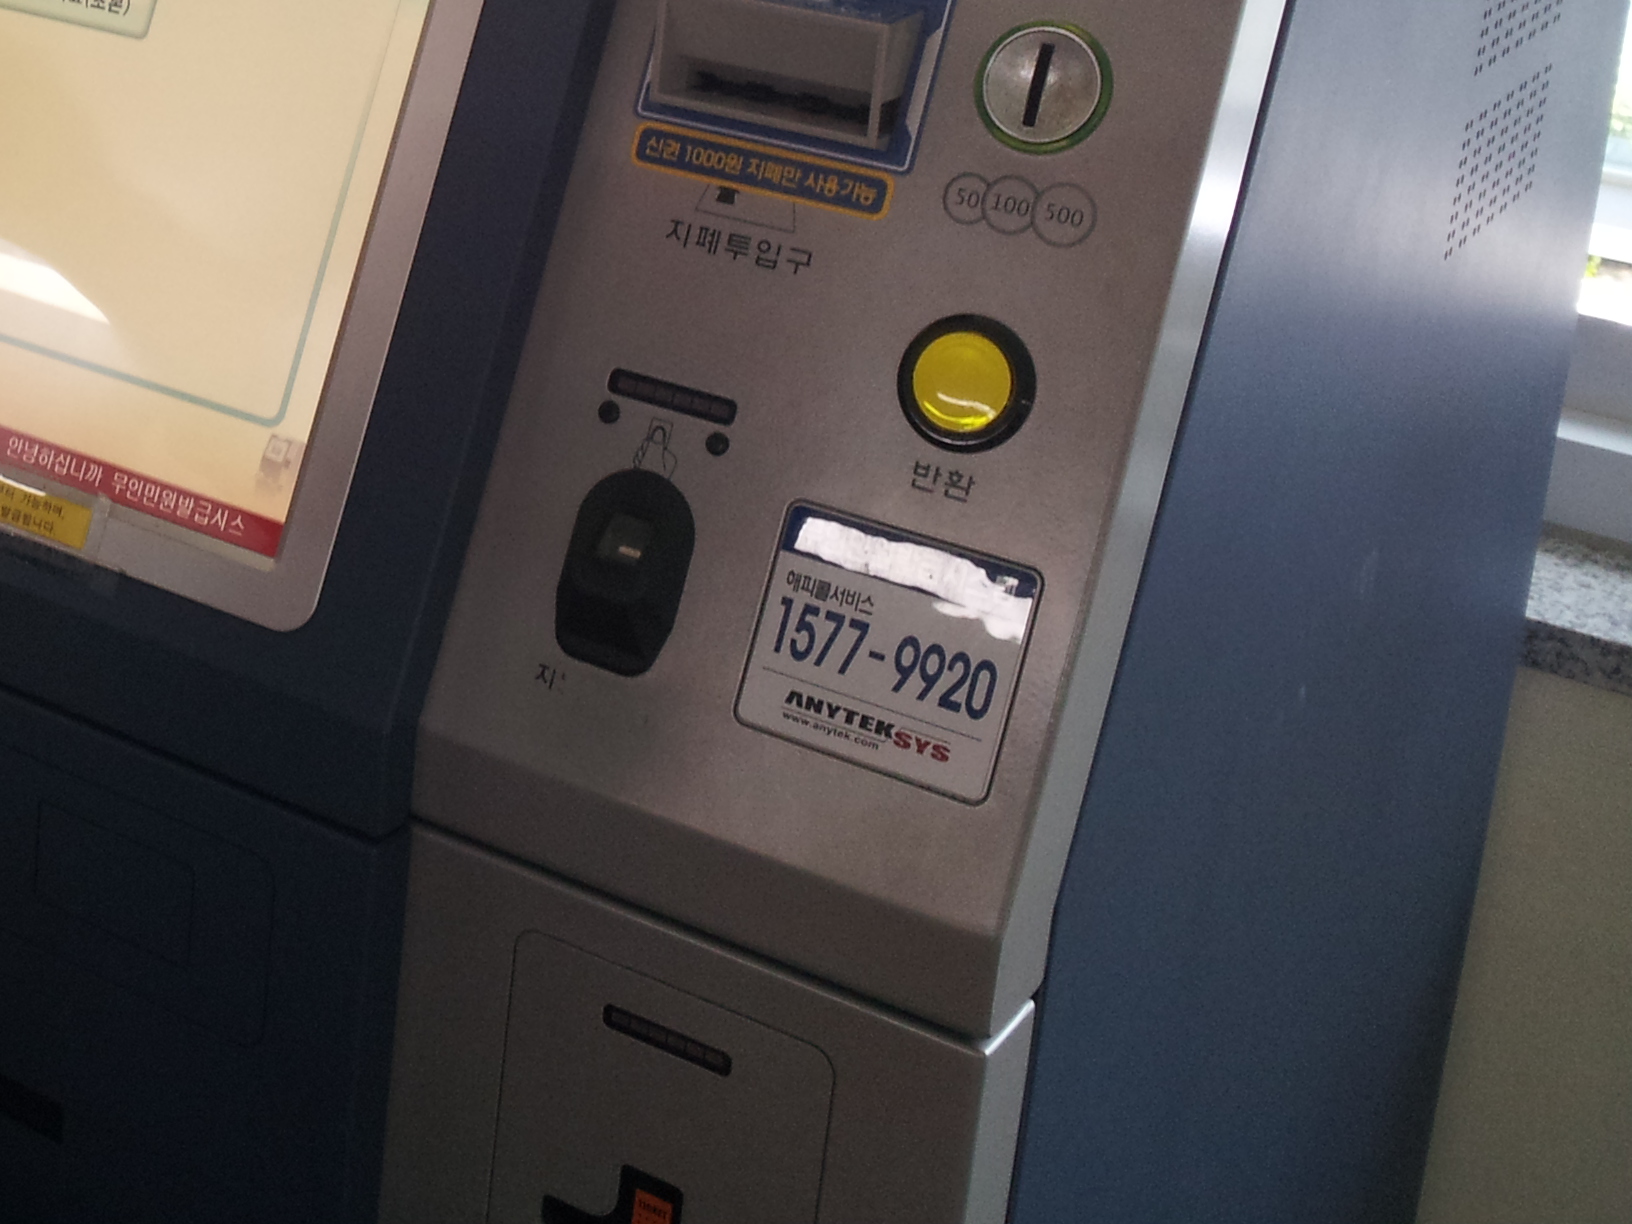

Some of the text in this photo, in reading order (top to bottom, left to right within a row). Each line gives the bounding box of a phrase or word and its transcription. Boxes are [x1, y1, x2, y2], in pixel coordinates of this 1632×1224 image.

[645, 135, 681, 162] 신권
[685, 145, 744, 175] 1000원
[956, 187, 980, 208] 50
[990, 192, 1030, 218] 100
[1045, 203, 1084, 229] 500
[666, 218, 813, 276] 지폐투입구
[6, 435, 246, 537] 안녕하십니까 무인민원발급시스
[911, 460, 976, 503] 반환
[773, 595, 998, 720] 1577-9920
[781, 709, 880, 752] www.anytek.com
[783, 688, 951, 763] ANYTEKSYS
